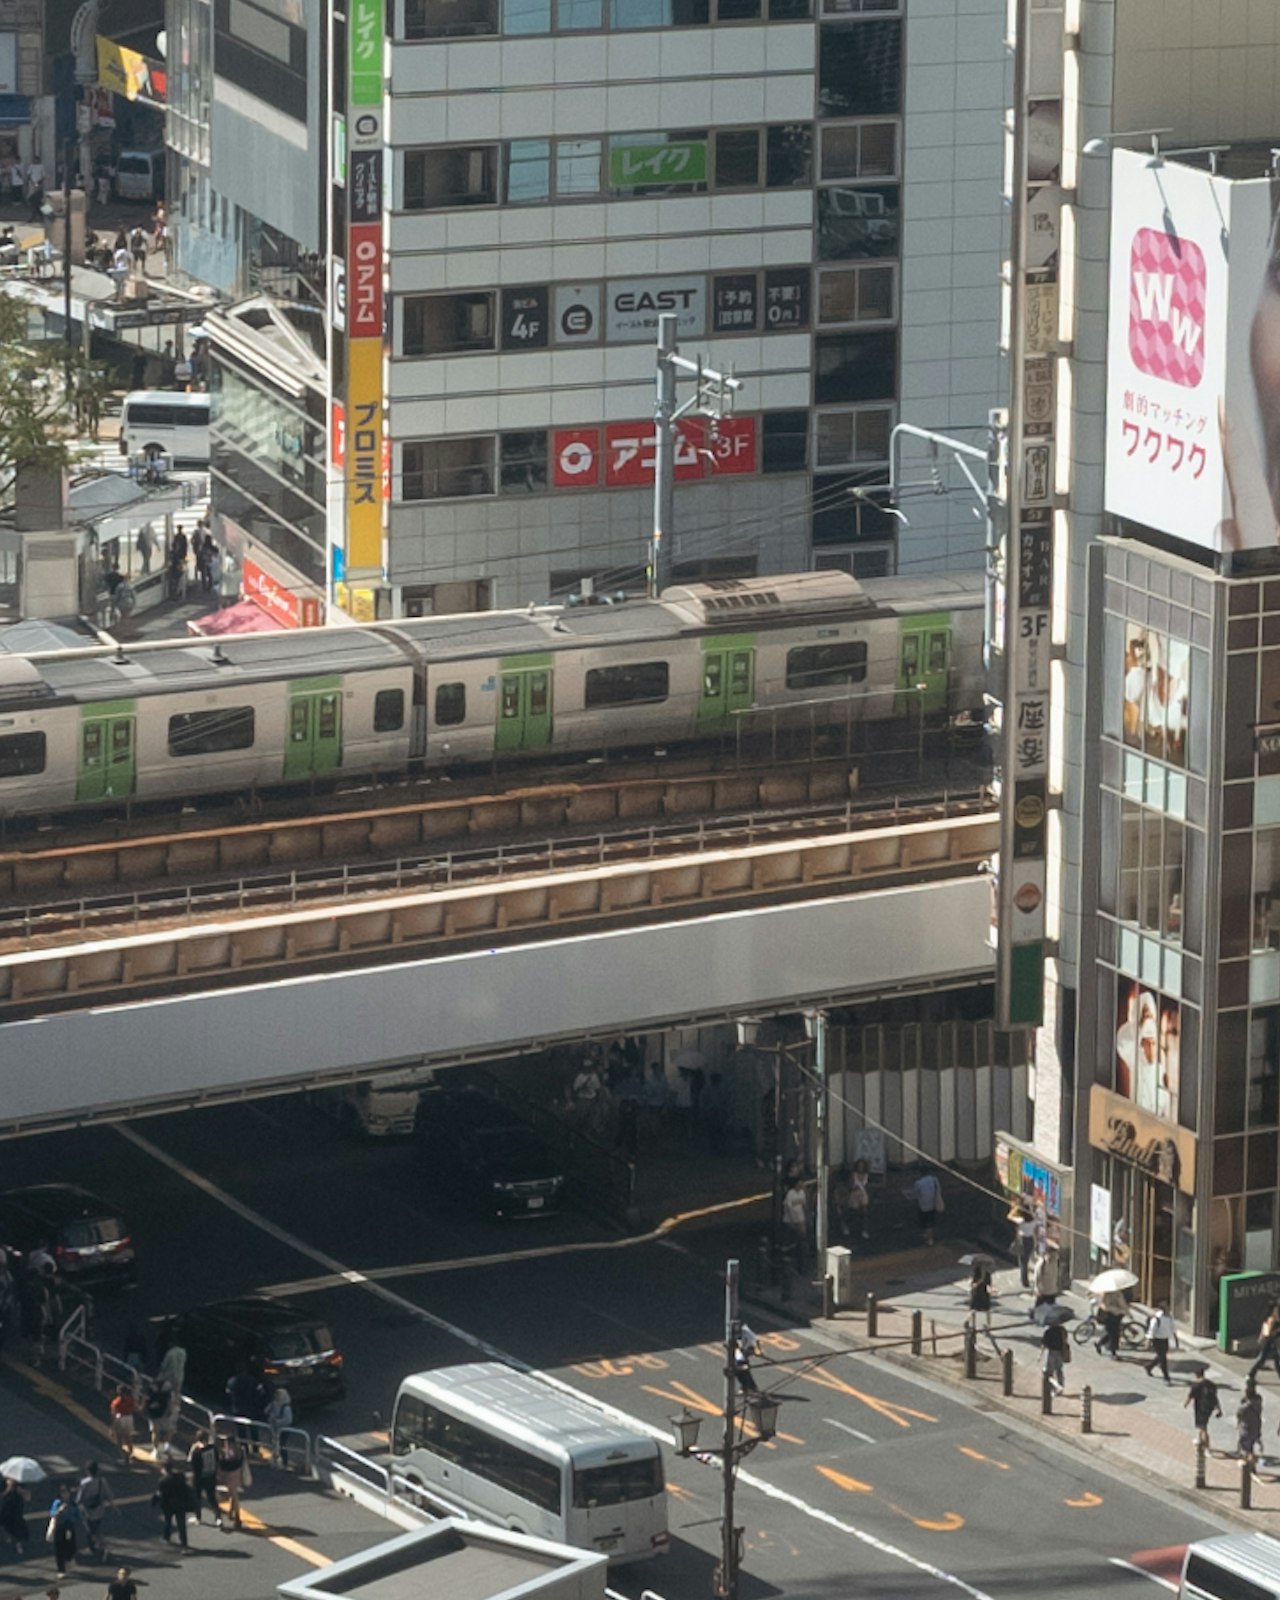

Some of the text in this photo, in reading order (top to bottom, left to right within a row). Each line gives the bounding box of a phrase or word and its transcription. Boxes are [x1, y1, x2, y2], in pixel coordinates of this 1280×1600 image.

[357, 2, 376, 61] レイク
[621, 146, 691, 176] レイク
[358, 265, 376, 324] アコム
[614, 289, 698, 312] EAST
[510, 313, 540, 340] 4F
[354, 401, 378, 504] プロミス
[718, 434, 750, 459] 3F
[1121, 418, 1207, 480] ワクワク
[1021, 614, 1048, 637] 3F
